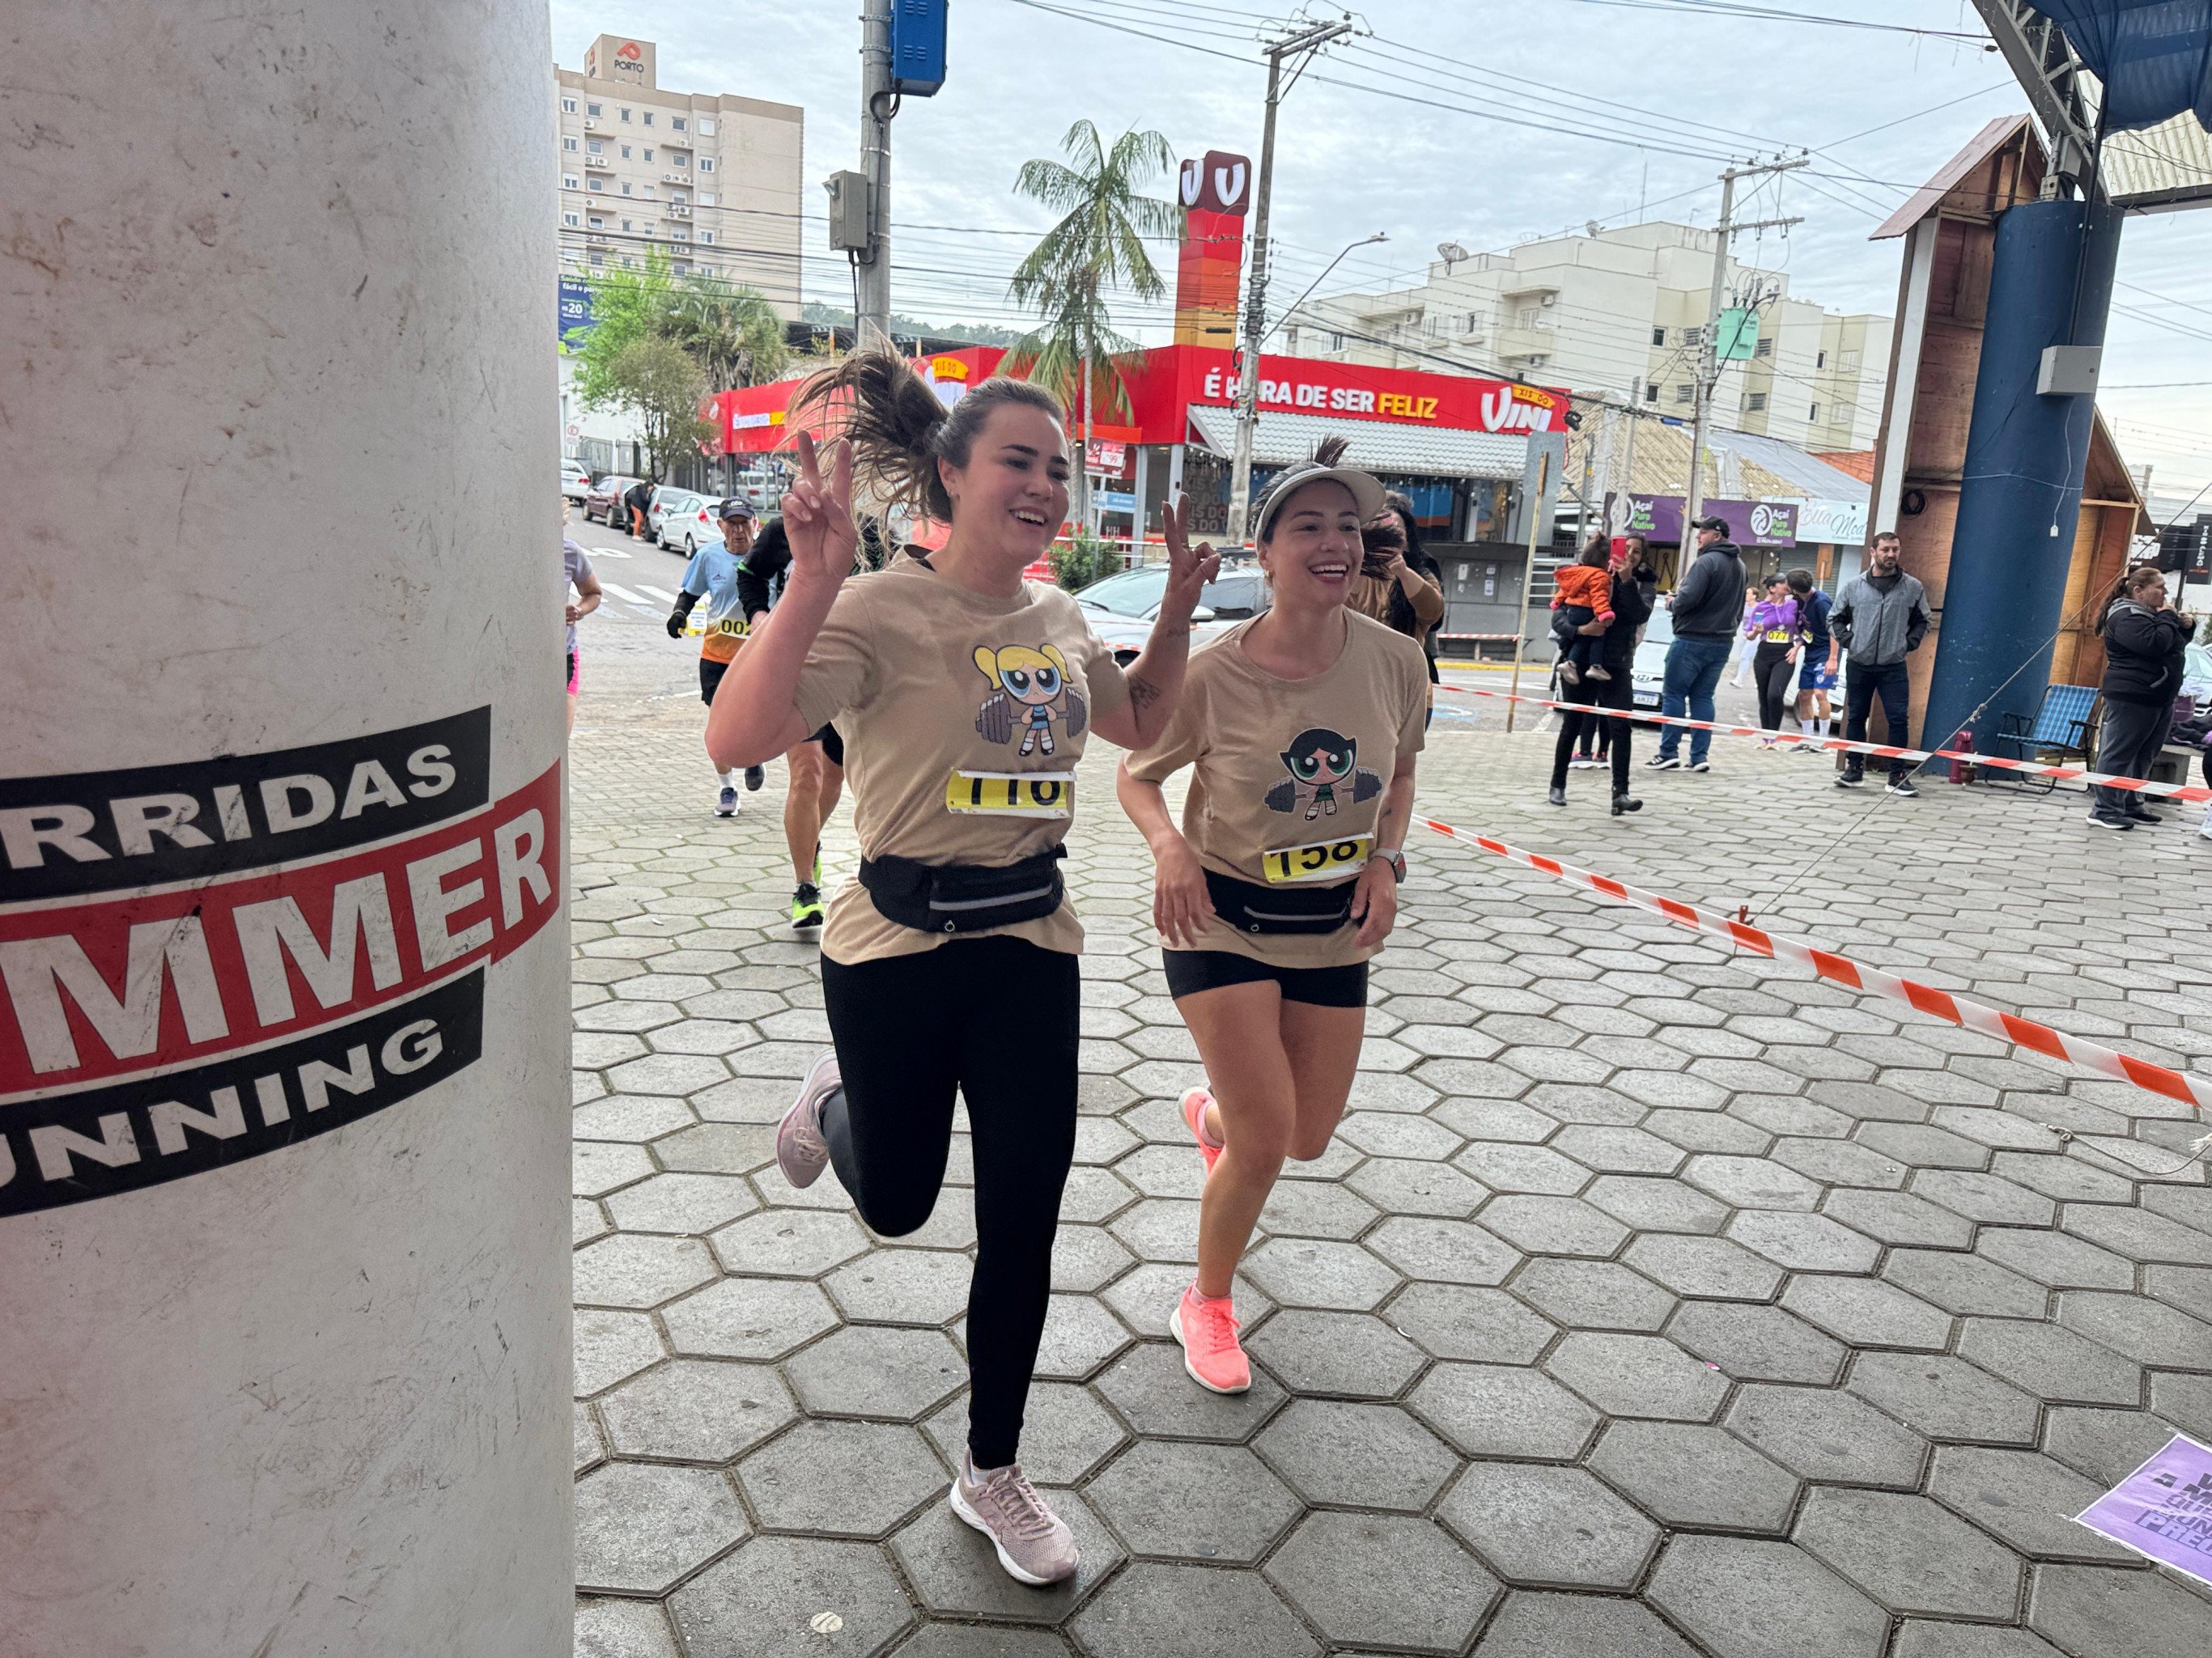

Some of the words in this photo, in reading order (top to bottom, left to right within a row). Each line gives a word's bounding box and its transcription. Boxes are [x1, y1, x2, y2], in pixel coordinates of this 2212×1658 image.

[614, 60, 644, 73] PORTO
[568, 303, 583, 315] 20
[1204, 367, 1221, 399] É
[1225, 376, 1293, 405] HRA
[1296, 384, 1328, 409] DE
[1331, 388, 1375, 413] SER
[1378, 393, 1439, 420] FELIZ
[1519, 388, 1532, 399] XIS
[1537, 394, 1549, 405] DO
[1768, 631, 1787, 640] 077
[0, 744, 456, 870] RRIDAS
[1270, 840, 1359, 877] 158
[0, 808, 553, 1075] MMER
